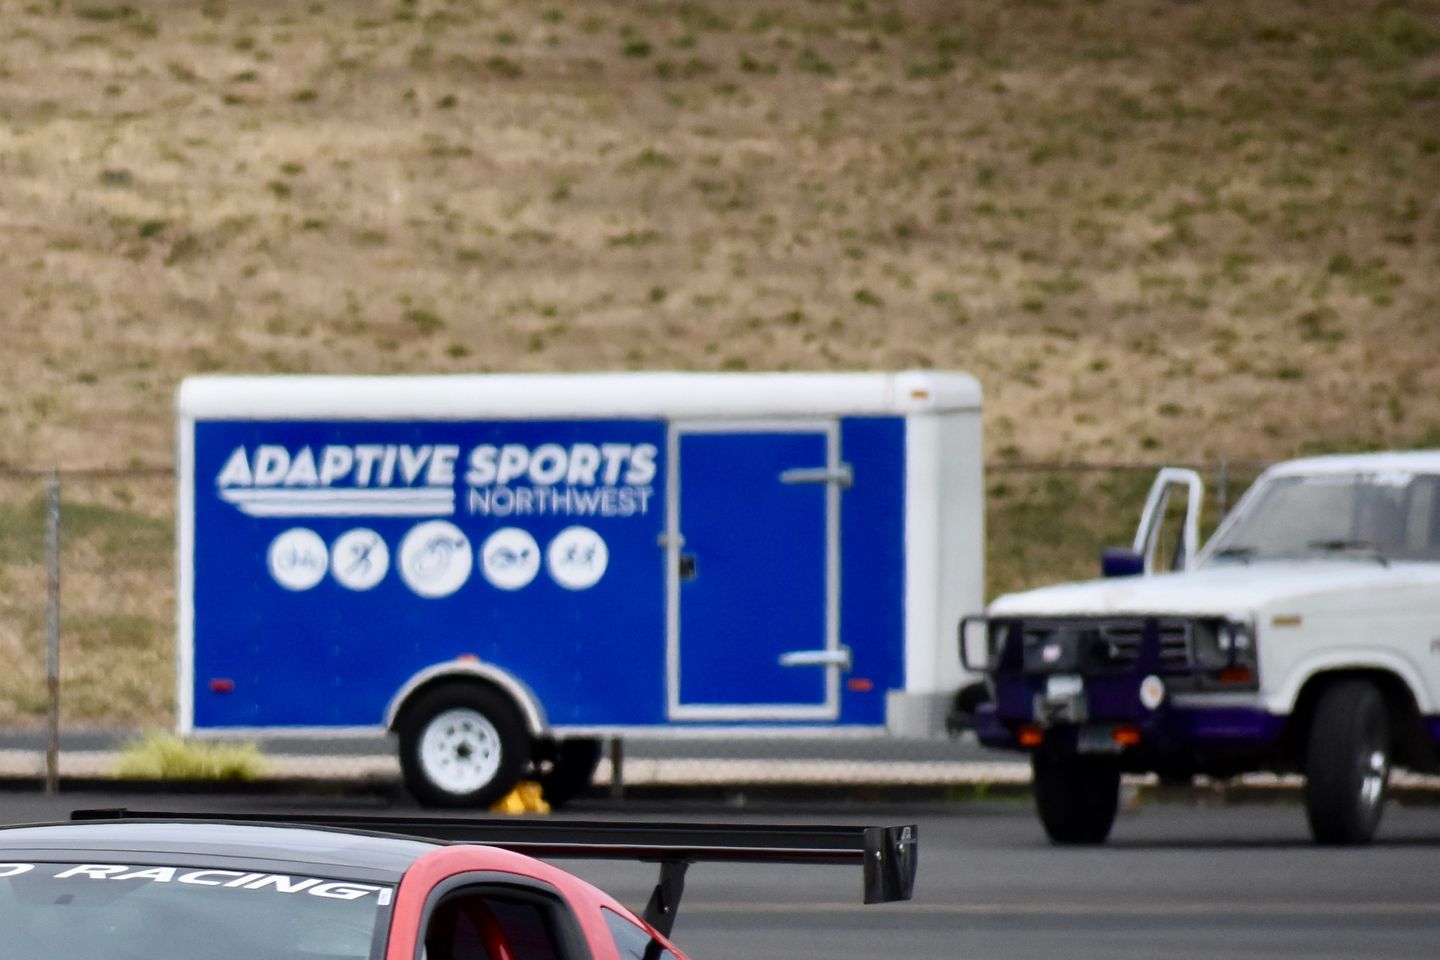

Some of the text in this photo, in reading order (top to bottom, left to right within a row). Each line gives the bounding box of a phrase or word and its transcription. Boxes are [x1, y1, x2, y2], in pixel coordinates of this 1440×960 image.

[216, 443, 659, 487] ADAPTIVE SPORTS
[468, 486, 654, 517] NORTHWEST
[54, 864, 381, 900] RACING
